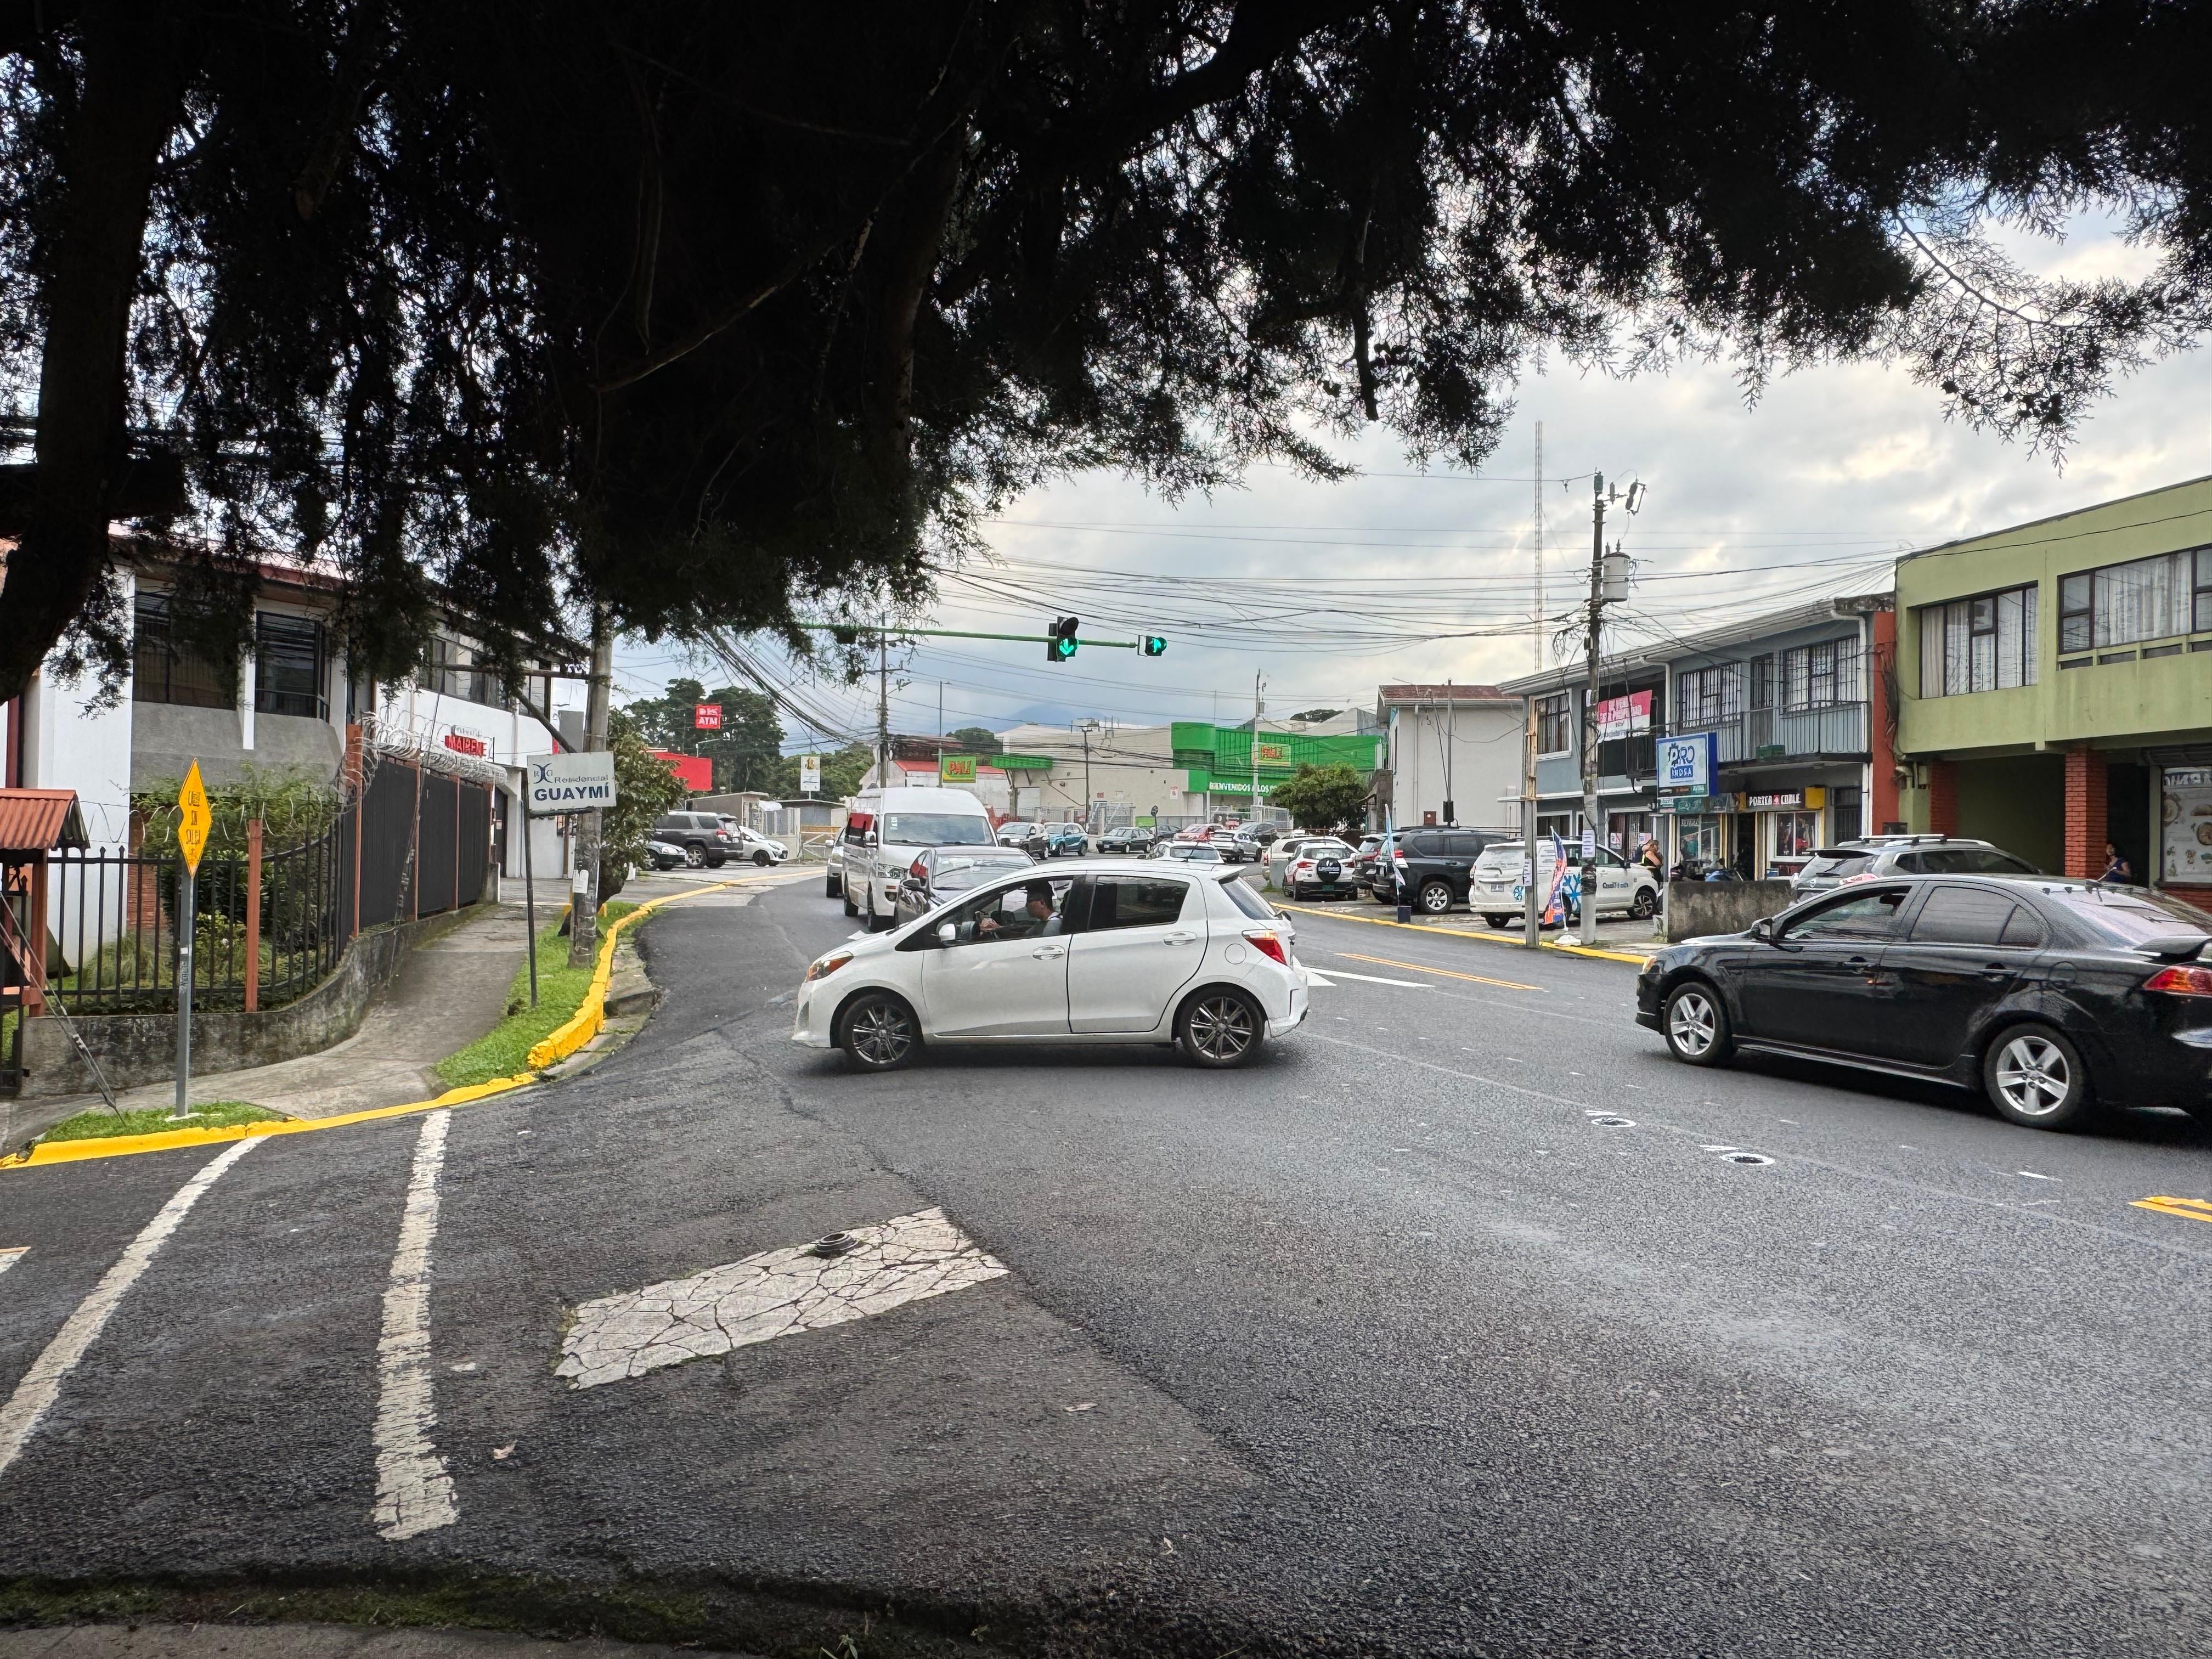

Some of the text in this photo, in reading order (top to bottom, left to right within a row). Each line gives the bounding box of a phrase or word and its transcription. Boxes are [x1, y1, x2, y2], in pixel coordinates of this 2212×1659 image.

[1668, 743, 1695, 766] PRO
[555, 775, 608, 783] Residencial
[534, 782, 610, 802] GUAYMÍ
